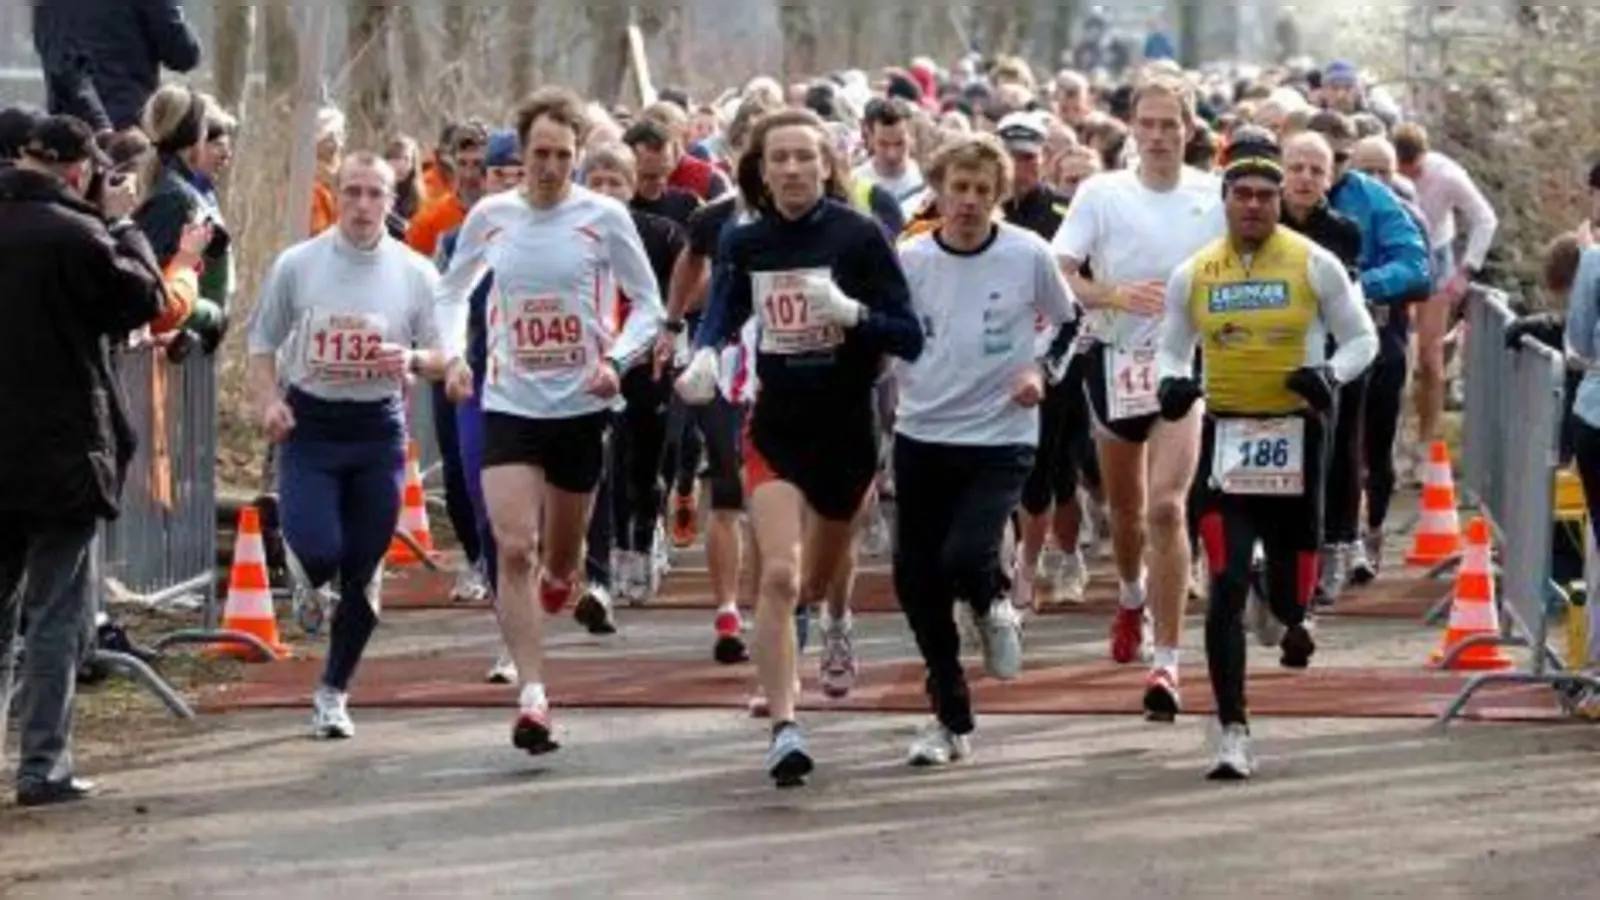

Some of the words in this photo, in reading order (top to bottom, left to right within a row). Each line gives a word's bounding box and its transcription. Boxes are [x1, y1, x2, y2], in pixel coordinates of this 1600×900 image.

[765, 292, 808, 327] 107
[314, 330, 382, 361] 1132
[513, 314, 582, 347] 1049
[1239, 437, 1289, 468] 186
